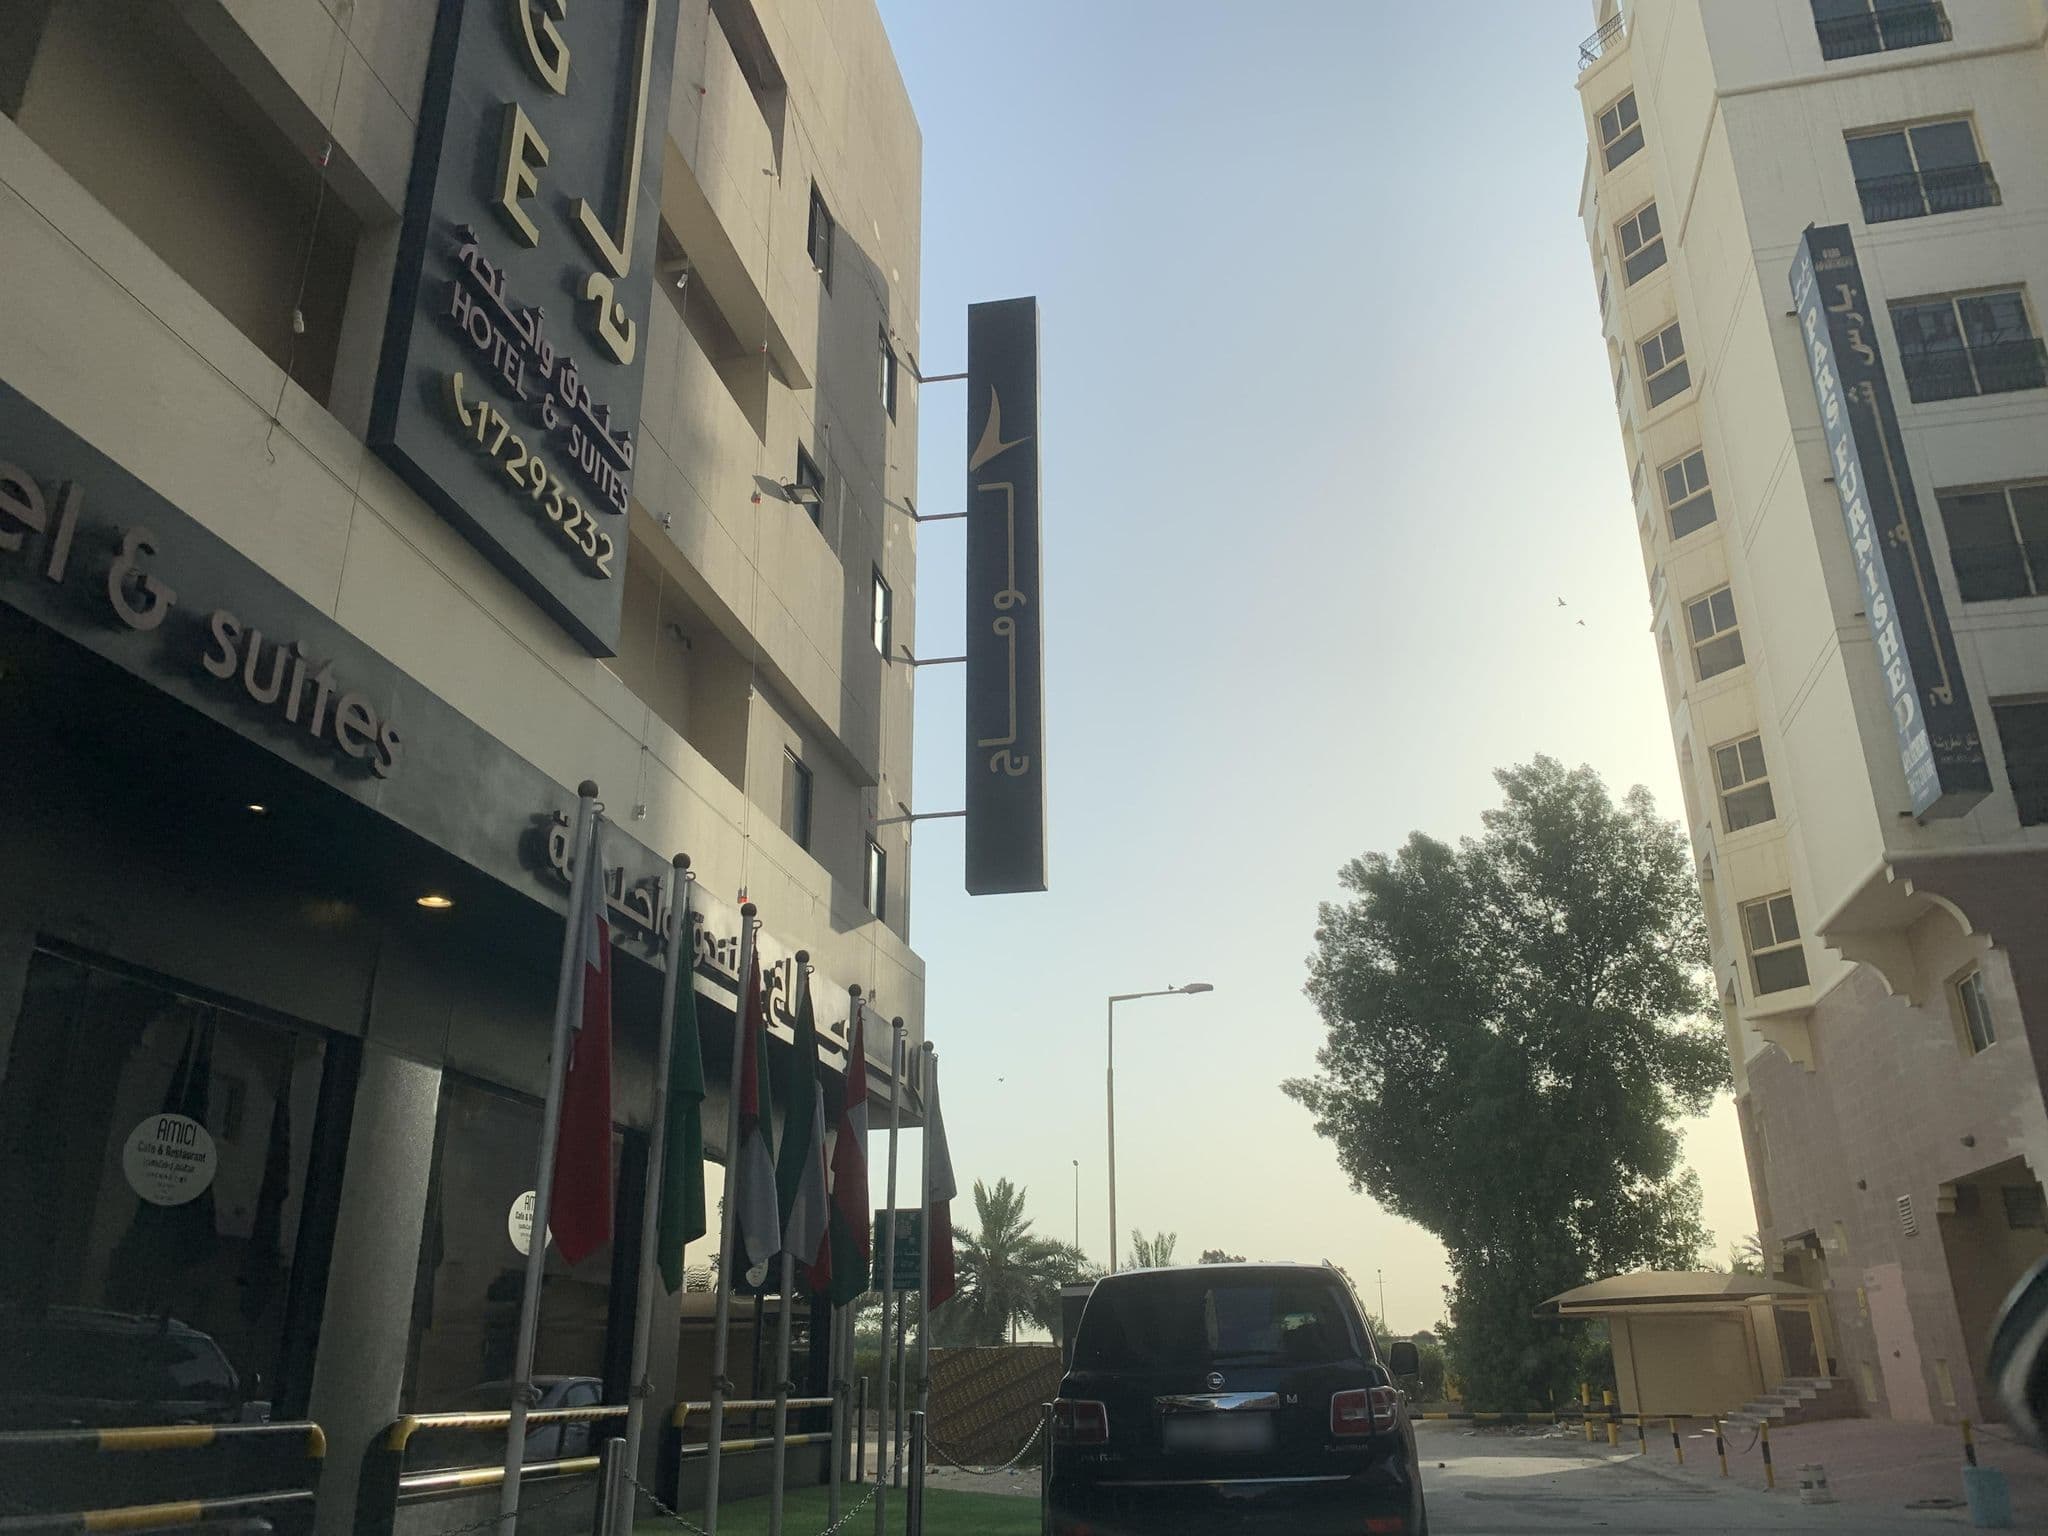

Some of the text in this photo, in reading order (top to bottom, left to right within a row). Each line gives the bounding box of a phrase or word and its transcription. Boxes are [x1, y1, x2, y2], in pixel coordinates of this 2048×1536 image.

[450, 281, 629, 515] HOTEL & SUITES
[560, 356, 633, 471] فندق
[475, 401, 615, 579] 17293232
[108, 527, 177, 631] &
[203, 608, 400, 780] suites
[156, 1117, 198, 1147] AMICI
[165, 1145, 207, 1163] Restaurant
